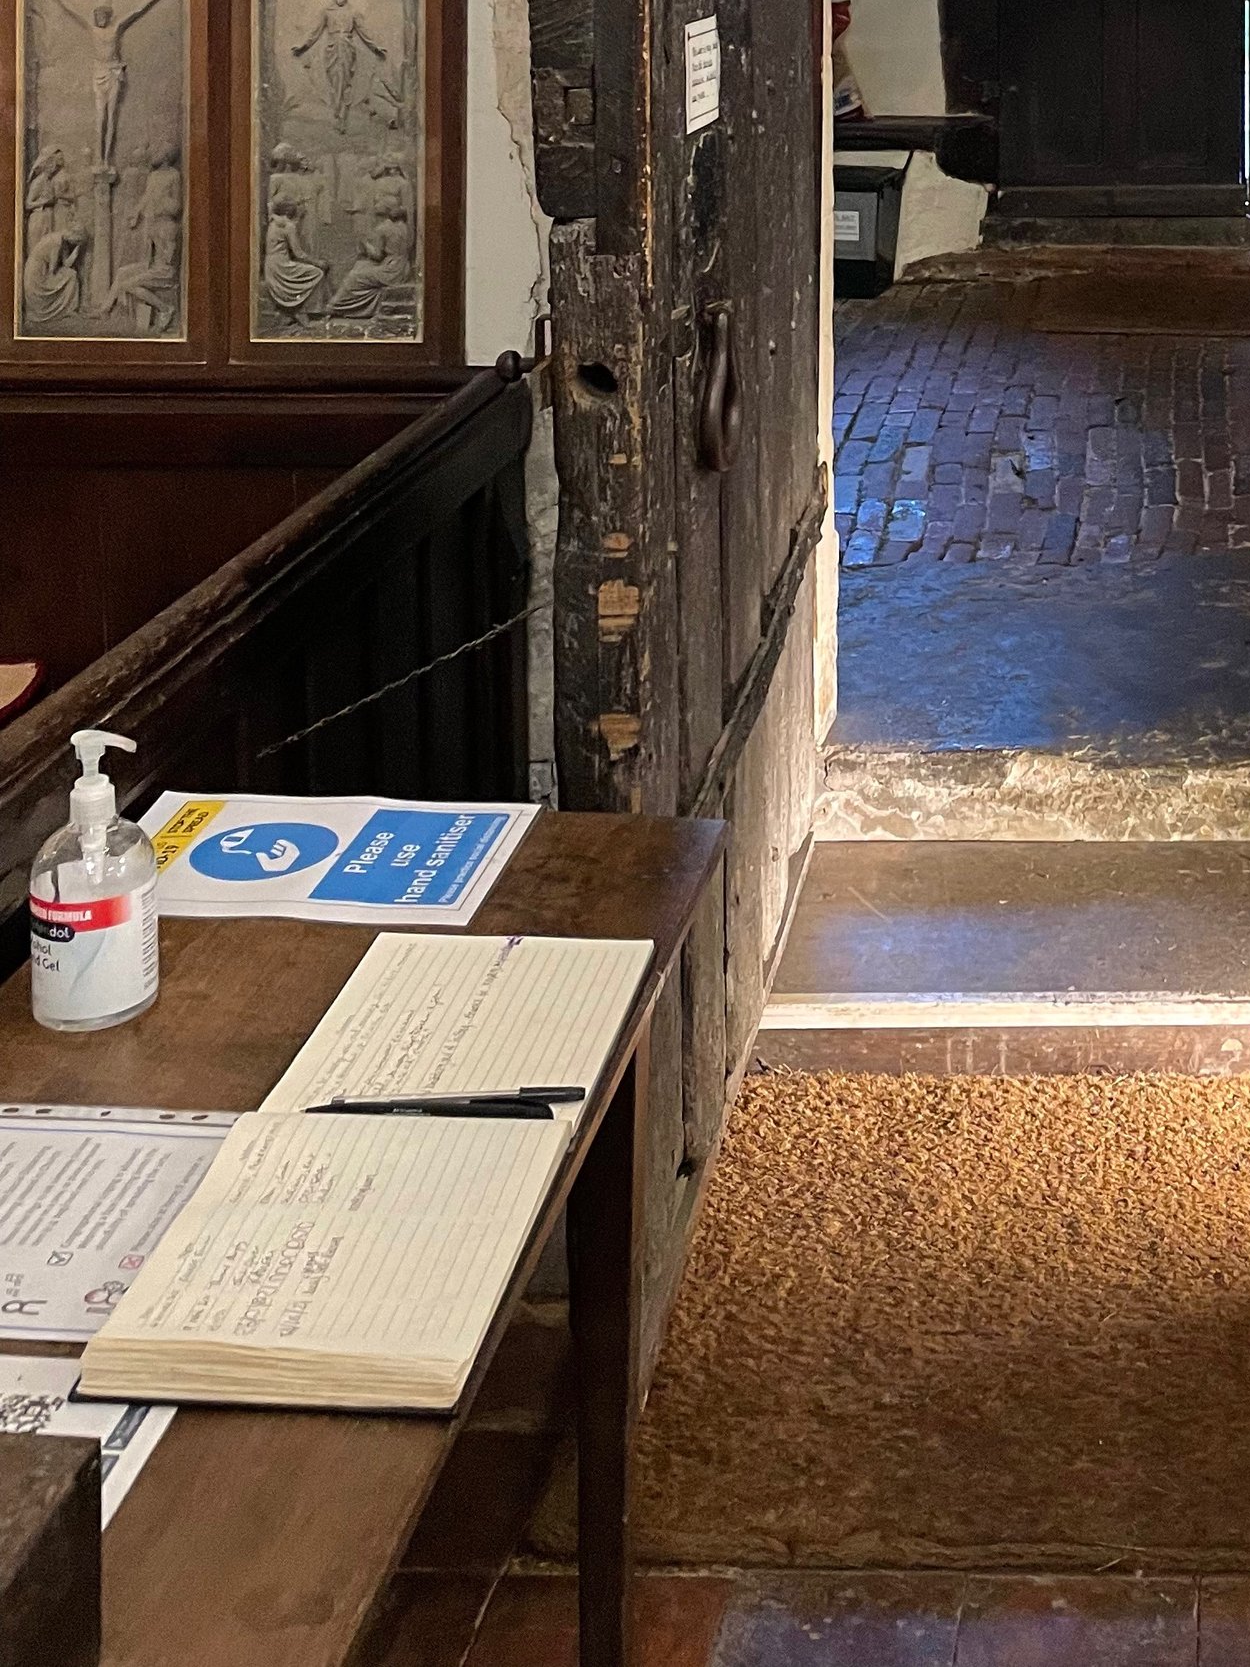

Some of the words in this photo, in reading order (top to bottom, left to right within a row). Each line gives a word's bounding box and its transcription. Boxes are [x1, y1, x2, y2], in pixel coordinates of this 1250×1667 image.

[343, 832, 394, 874] Please
[391, 844, 421, 867] use
[394, 869, 437, 903] hand
[426, 814, 476, 867] sanitiser
